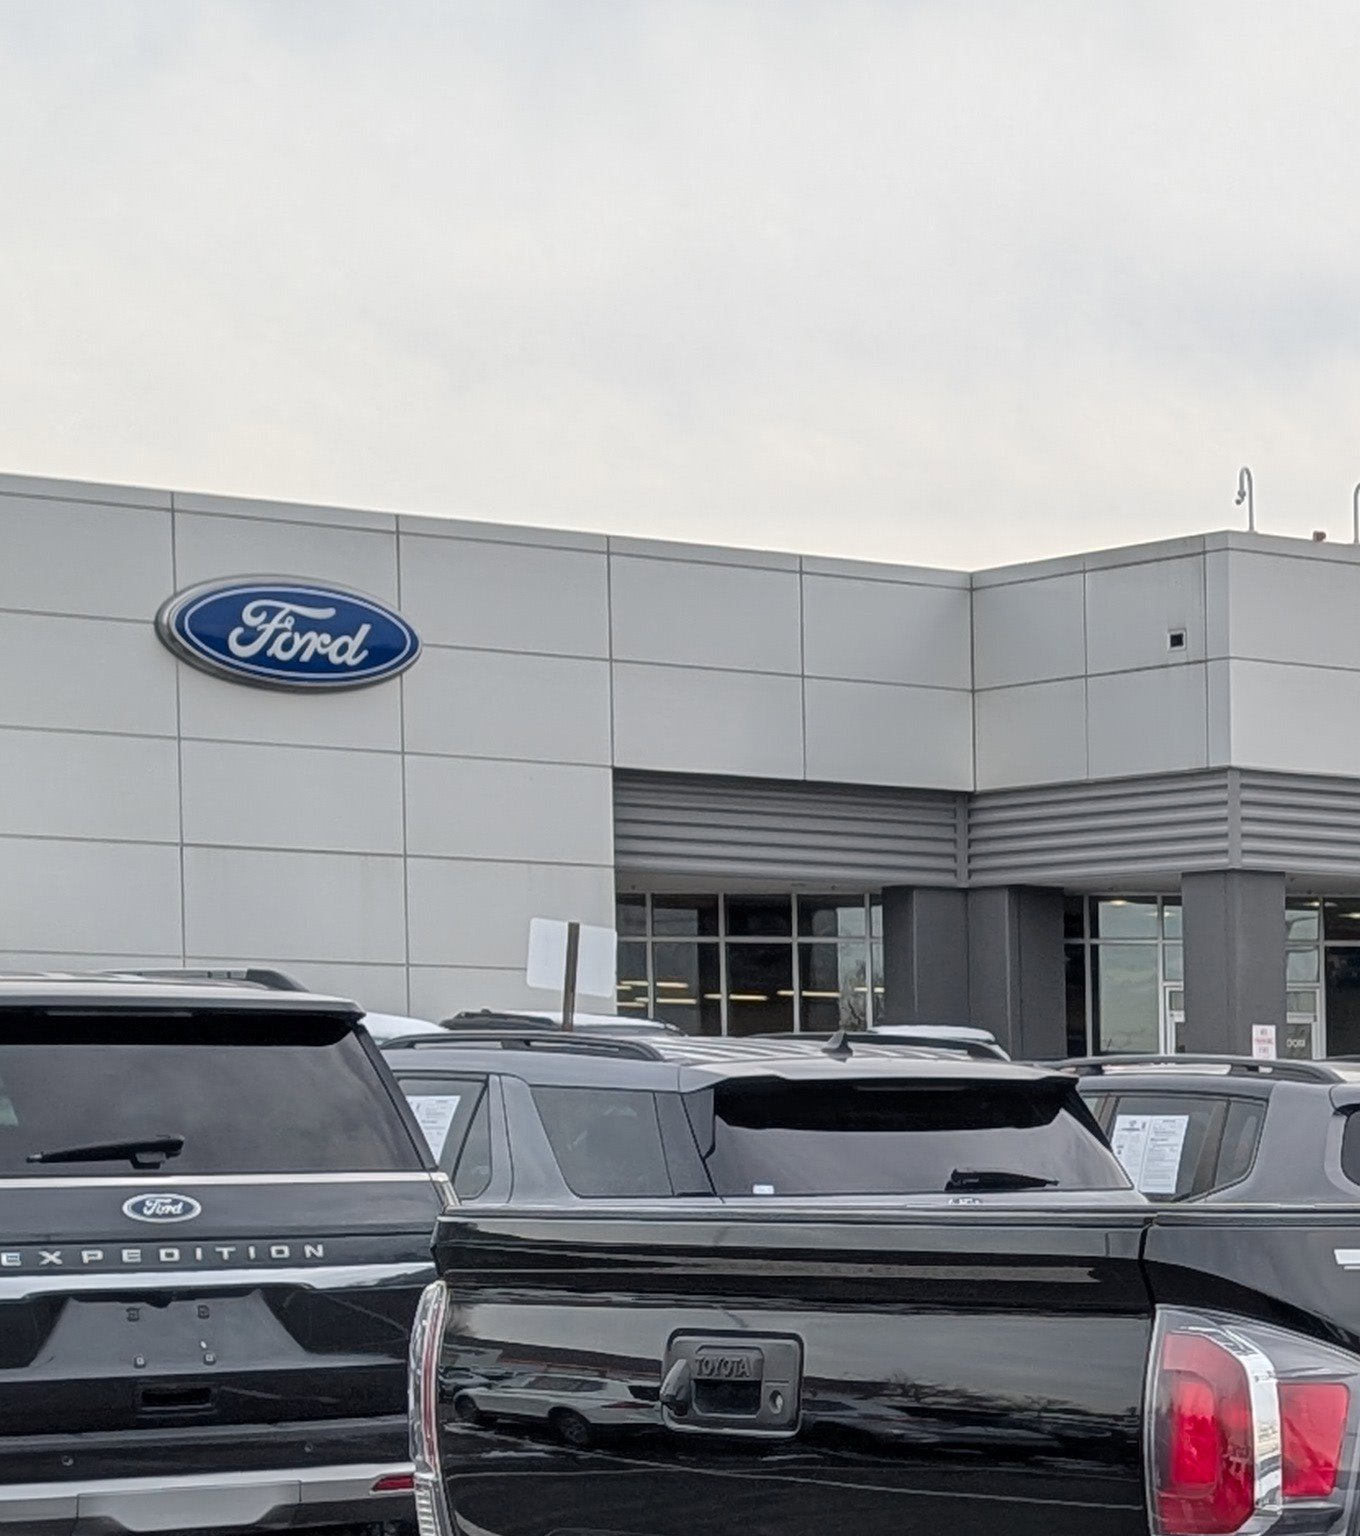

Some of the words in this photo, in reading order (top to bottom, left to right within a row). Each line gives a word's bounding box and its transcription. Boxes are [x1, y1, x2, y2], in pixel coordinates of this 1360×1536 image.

[227, 599, 372, 666] Ford
[143, 1197, 184, 1216] Ford
[0, 1243, 325, 1268] EXPEDITION
[695, 1357, 751, 1378] TOYOTA
